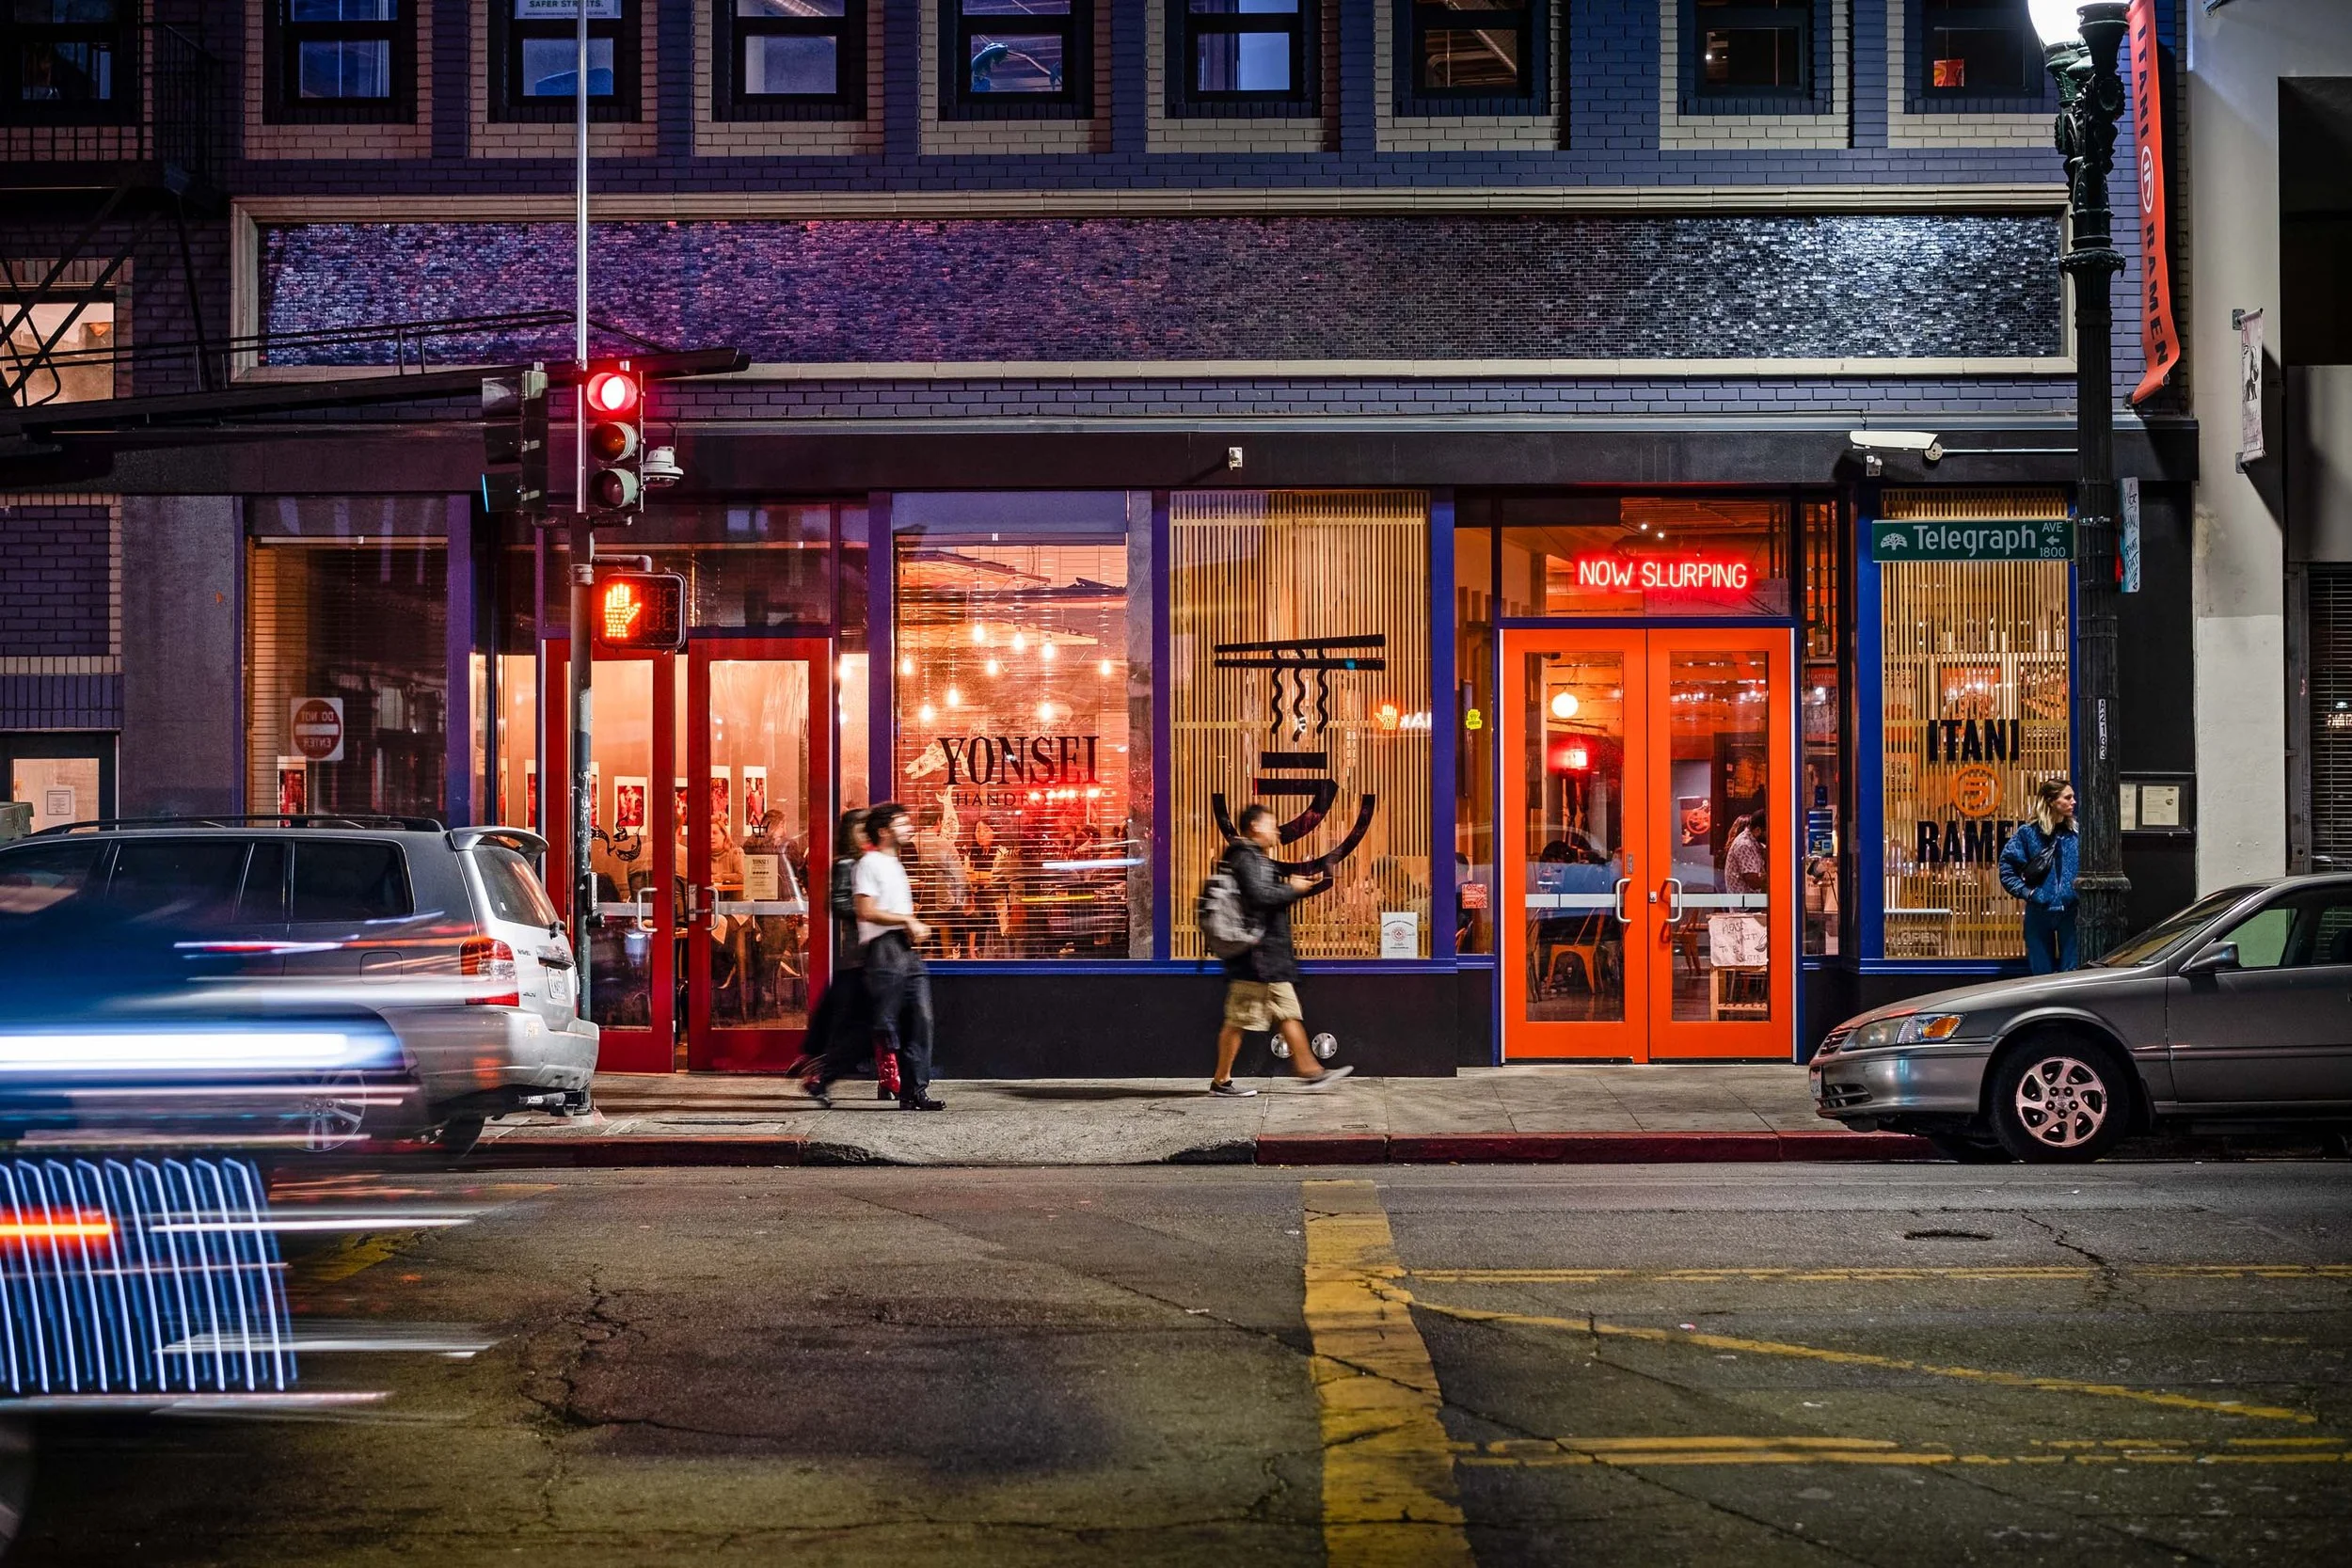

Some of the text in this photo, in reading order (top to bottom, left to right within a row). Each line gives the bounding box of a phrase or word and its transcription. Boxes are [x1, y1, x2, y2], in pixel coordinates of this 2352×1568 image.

[2137, 24, 2150, 140] ITANI
[2147, 221, 2169, 368] RAMEN
[1913, 521, 2064, 558] Telegraph AVE
[2039, 546, 2066, 558] 1800
[1579, 561, 1747, 589] NOW SLURPING
[937, 736, 1100, 784] YONSEI
[1929, 720, 2019, 761] ITANI
[1917, 820, 2026, 863] RAME
